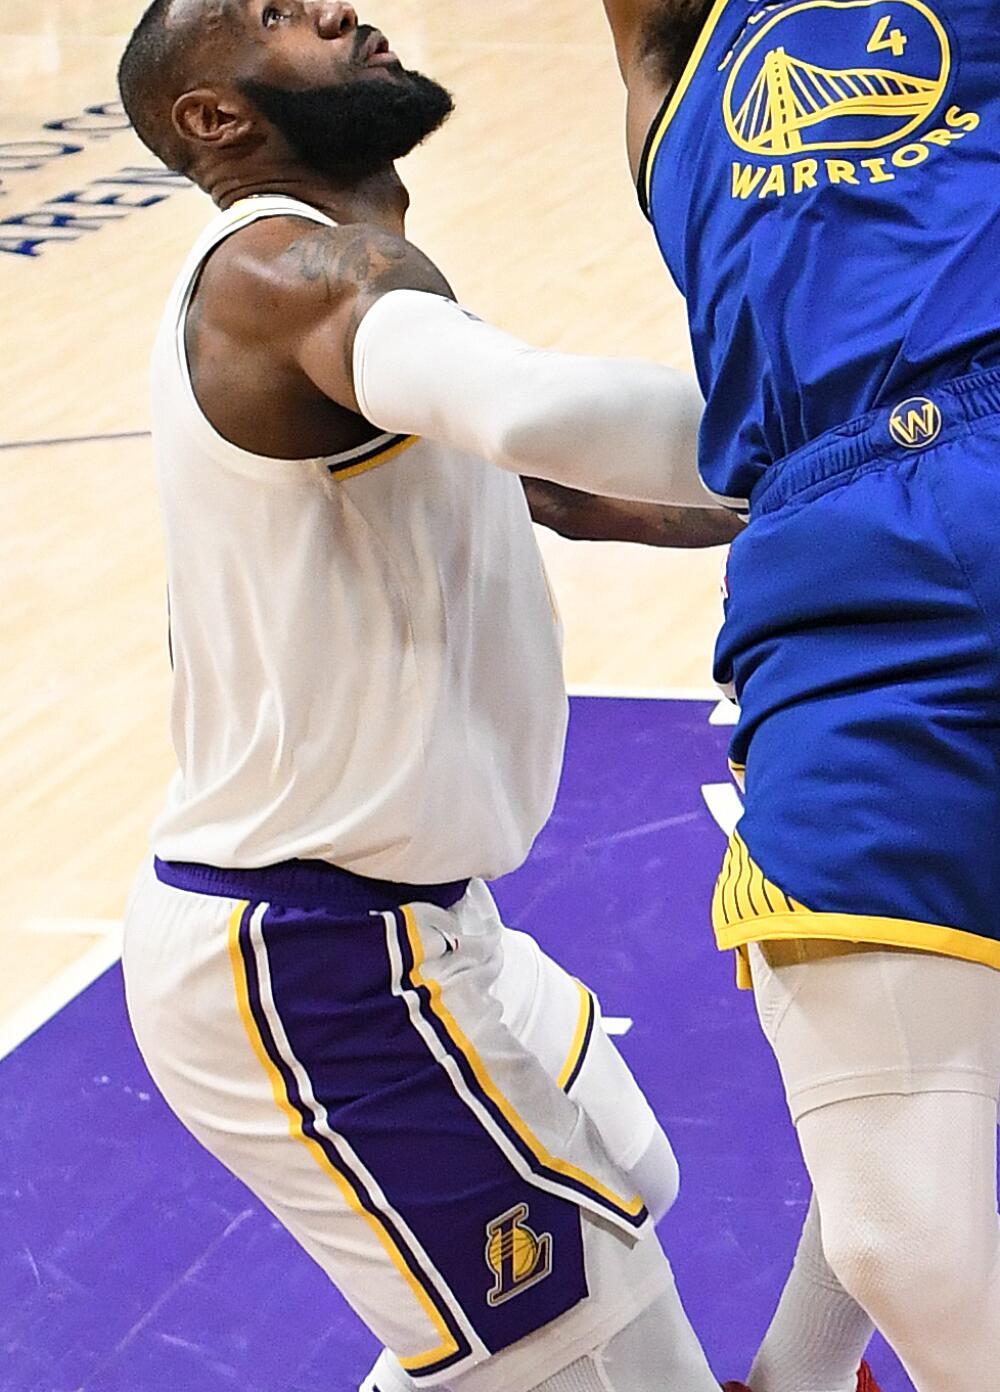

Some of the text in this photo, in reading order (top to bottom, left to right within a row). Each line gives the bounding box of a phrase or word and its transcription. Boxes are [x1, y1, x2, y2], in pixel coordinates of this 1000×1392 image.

[866, 15, 908, 57] 4
[731, 105, 981, 200] WARRIORS
[889, 401, 935, 444] W
